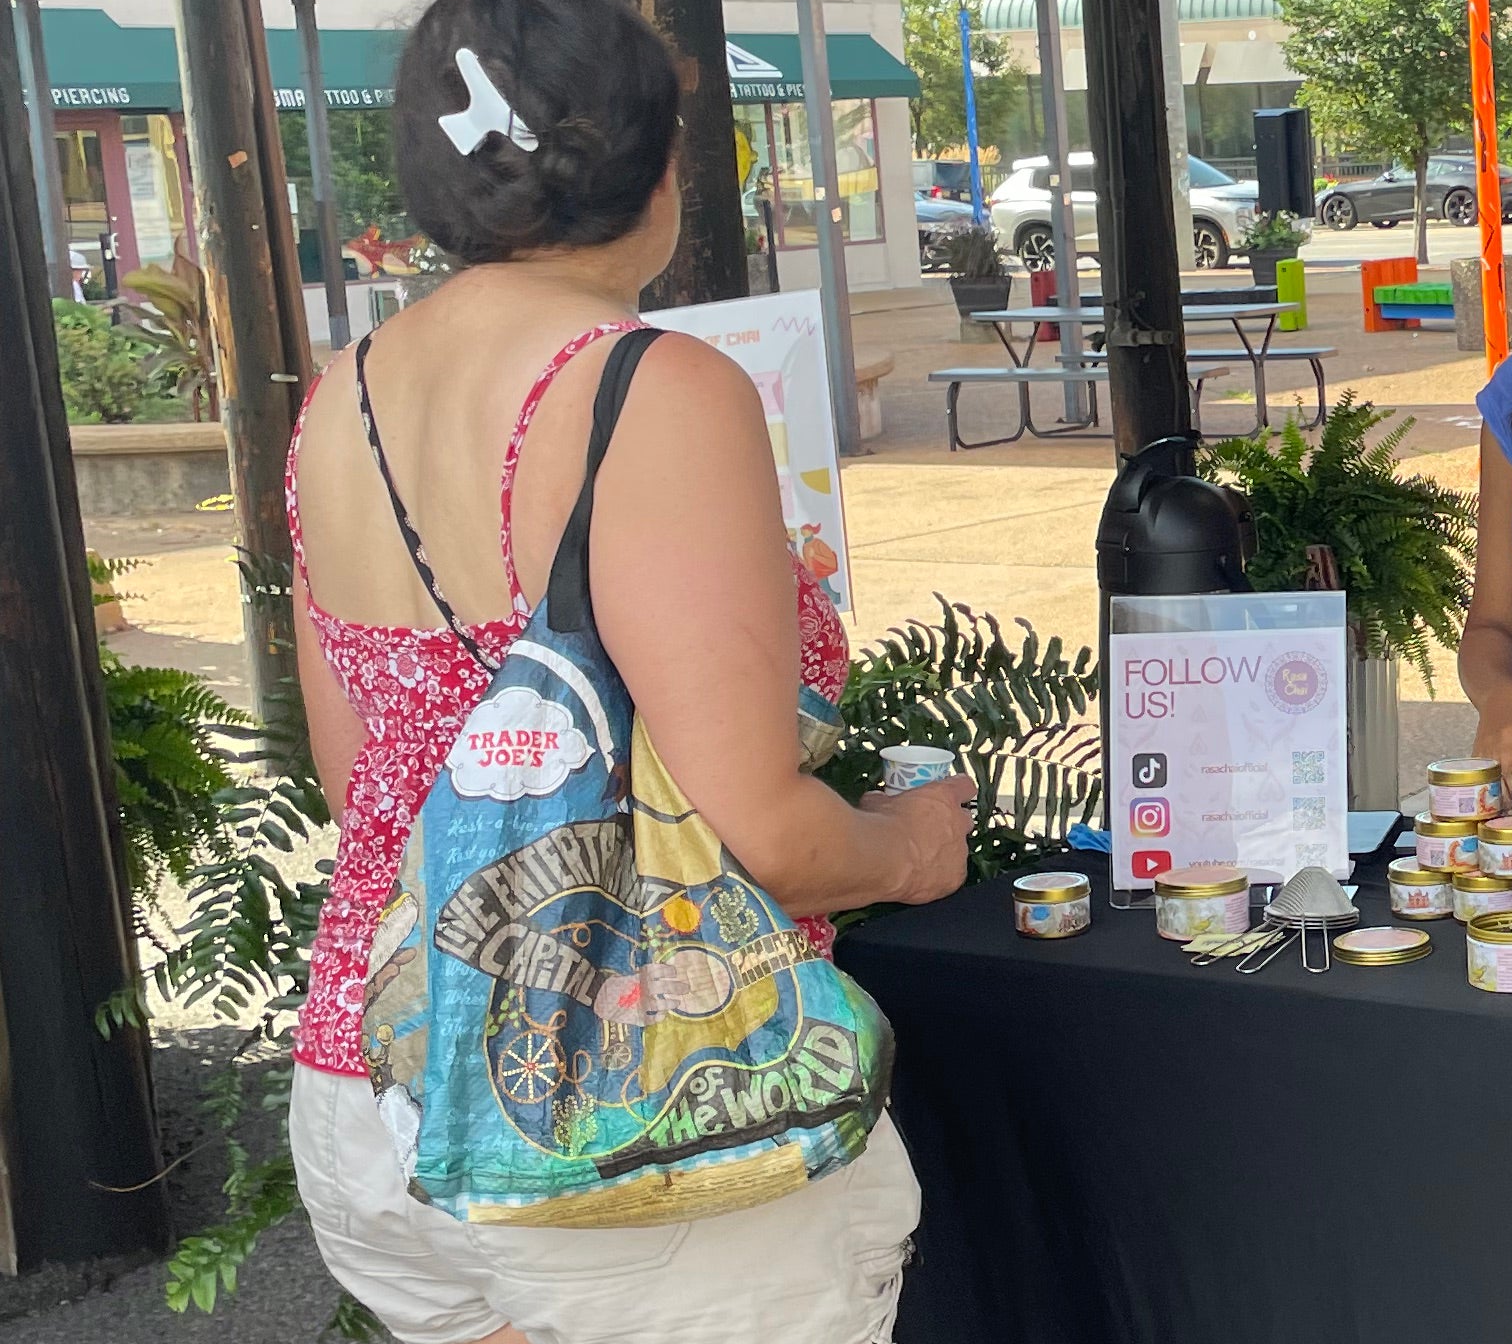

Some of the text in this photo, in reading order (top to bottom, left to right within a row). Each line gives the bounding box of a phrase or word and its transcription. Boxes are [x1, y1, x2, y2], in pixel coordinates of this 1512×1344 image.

[52, 86, 131, 106] PIERCING
[738, 83, 776, 97] TATTOO
[726, 329, 760, 347] CHAI
[1125, 655, 1262, 687] FOLLOW
[1125, 691, 1175, 720] US!
[467, 730, 560, 751] TRADER
[477, 748, 546, 768] JOE'S
[1200, 762, 1268, 774] rasachaiofficial
[1201, 810, 1269, 822] rasachaiofficial
[435, 882, 501, 960] LIVE
[479, 922, 600, 1006] CAPITAL
[688, 1066, 724, 1103] OF
[720, 1025, 856, 1129] WORLD
